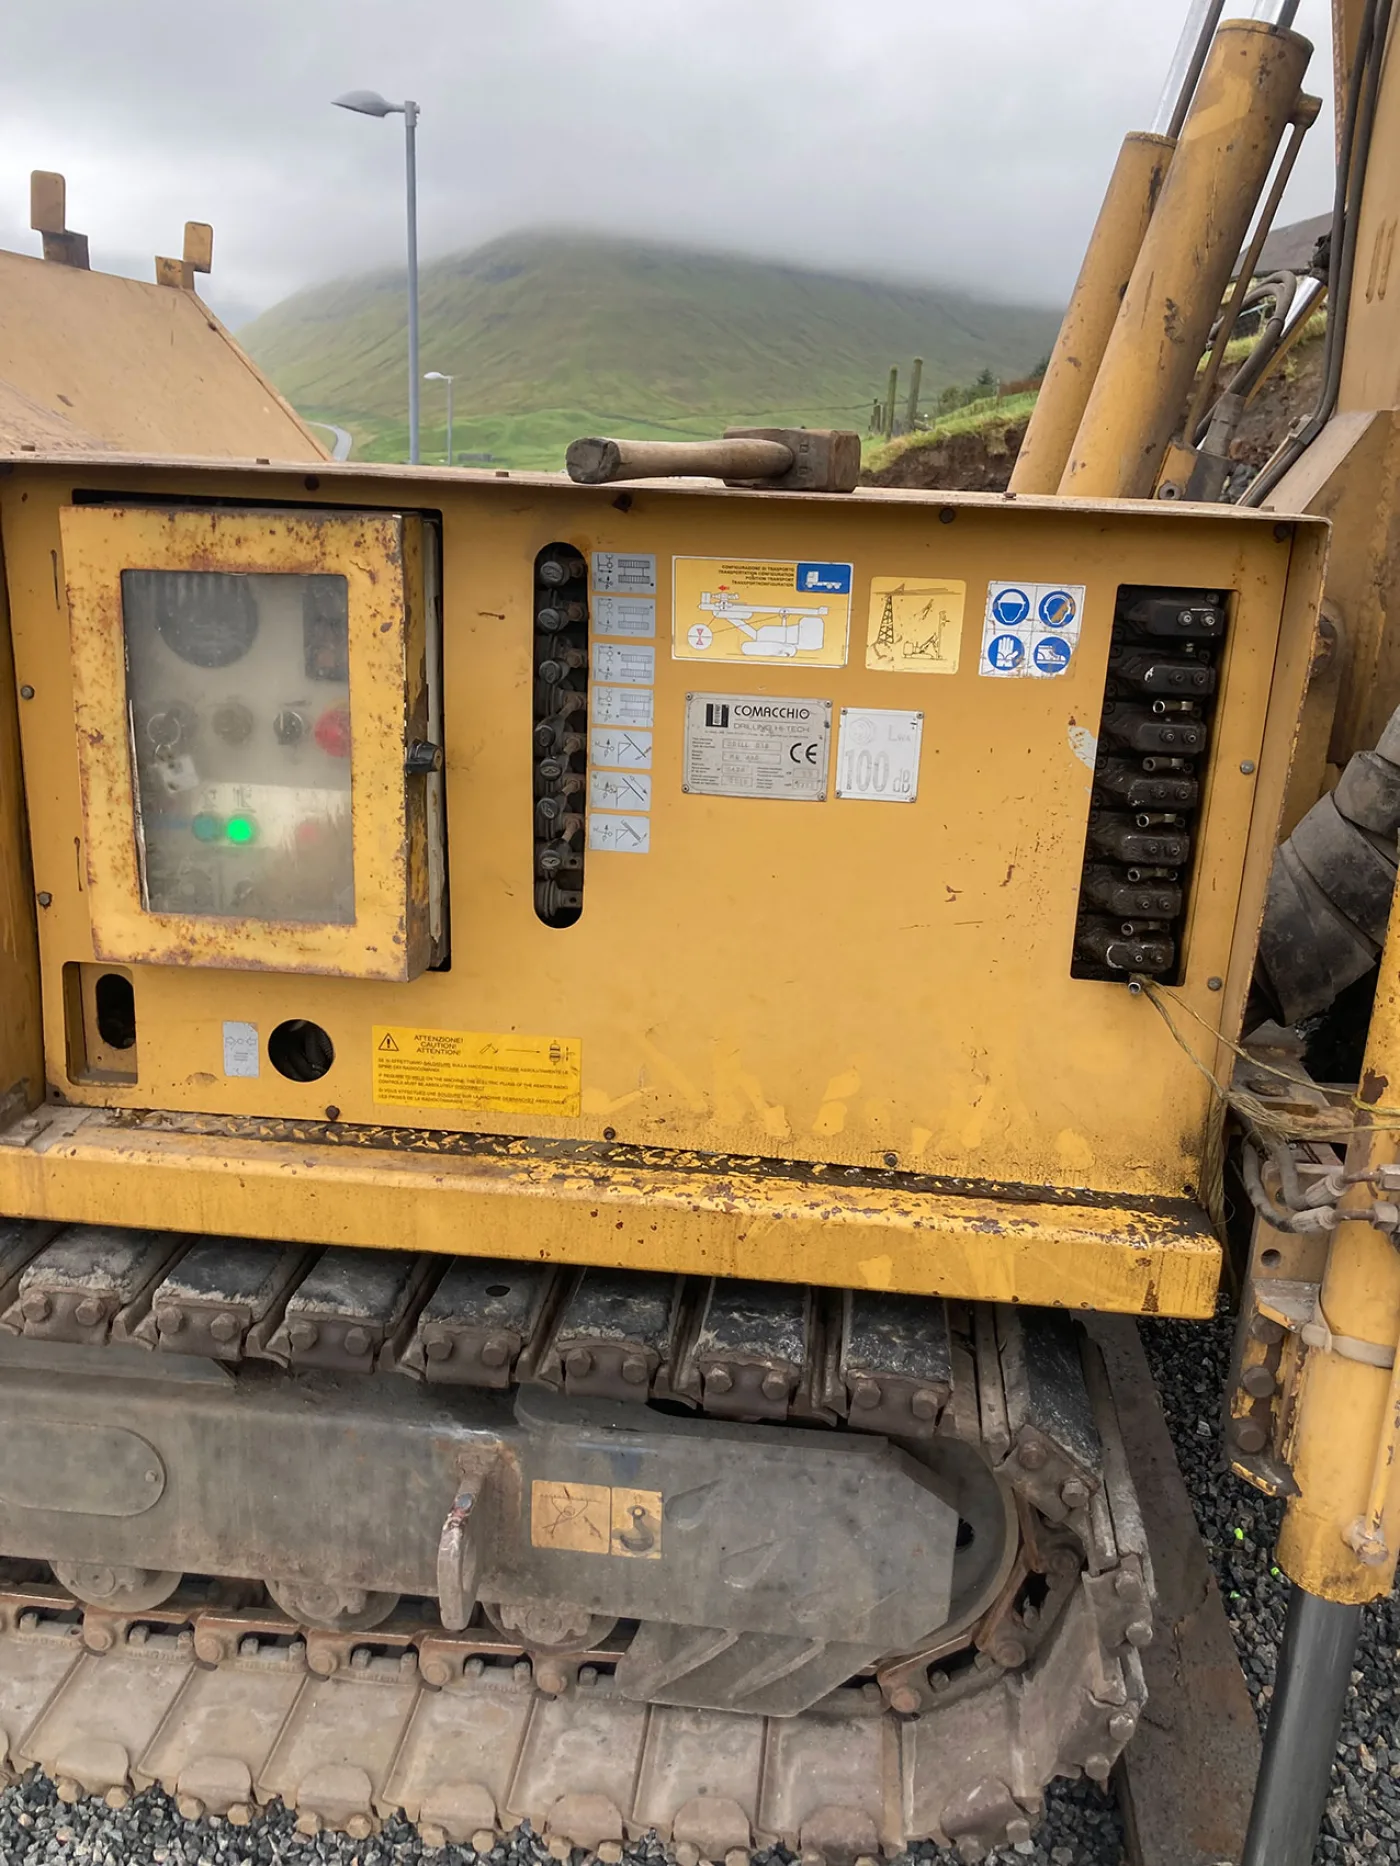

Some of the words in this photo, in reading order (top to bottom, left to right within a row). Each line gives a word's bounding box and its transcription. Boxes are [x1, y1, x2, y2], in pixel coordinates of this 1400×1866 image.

[734, 705, 810, 720] COMACCHIO
[789, 742, 818, 764] CE
[845, 749, 889, 792] 100
[414, 1034, 464, 1044] ATTENZIONE!
[420, 1041, 457, 1049] CAUTION!
[416, 1047, 461, 1056] ATTENTION!
